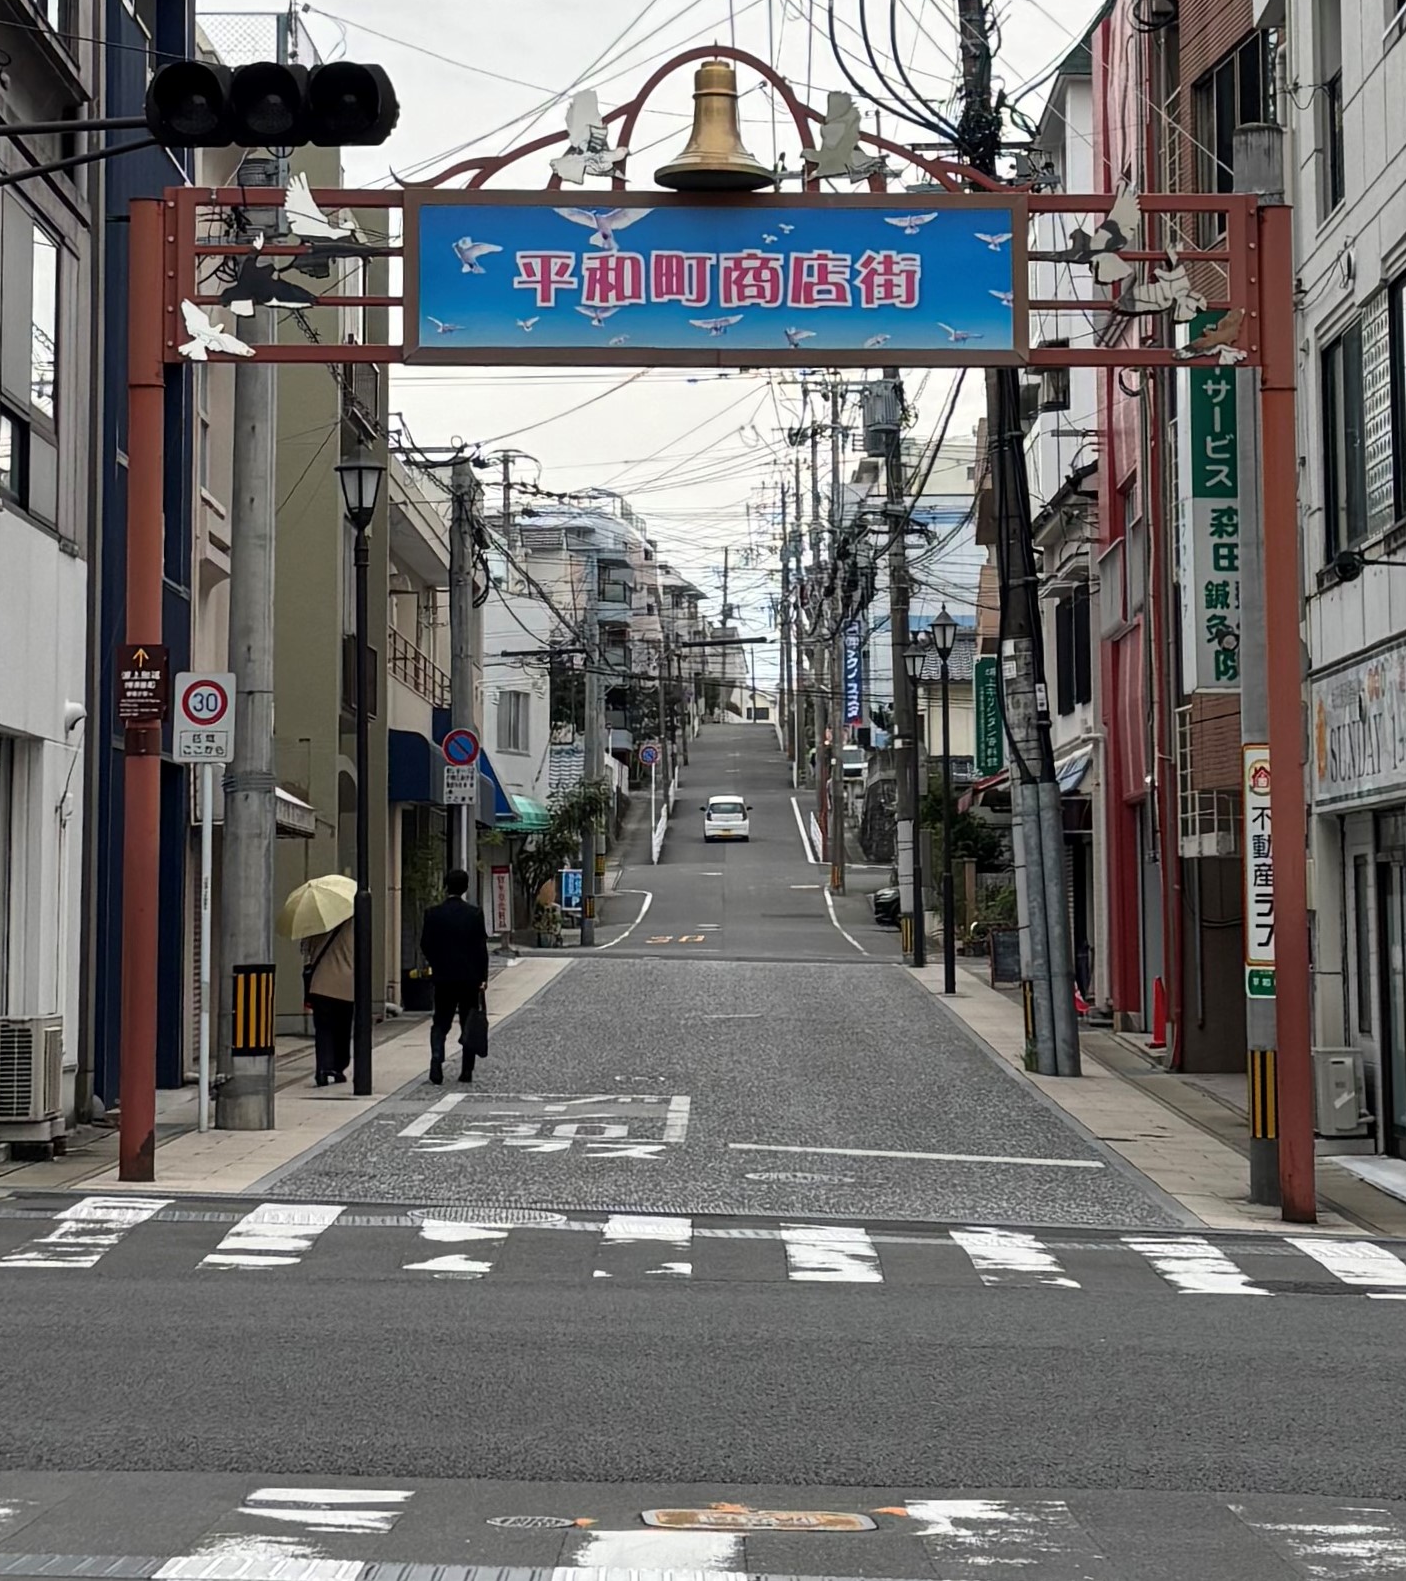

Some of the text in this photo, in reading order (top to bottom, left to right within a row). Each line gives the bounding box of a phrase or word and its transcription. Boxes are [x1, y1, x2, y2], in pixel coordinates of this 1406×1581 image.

[513, 249, 922, 309] 平和町商店街
[1201, 367, 1235, 488] サービス
[192, 692, 219, 713] 30
[460, 1122, 630, 1138] 30
